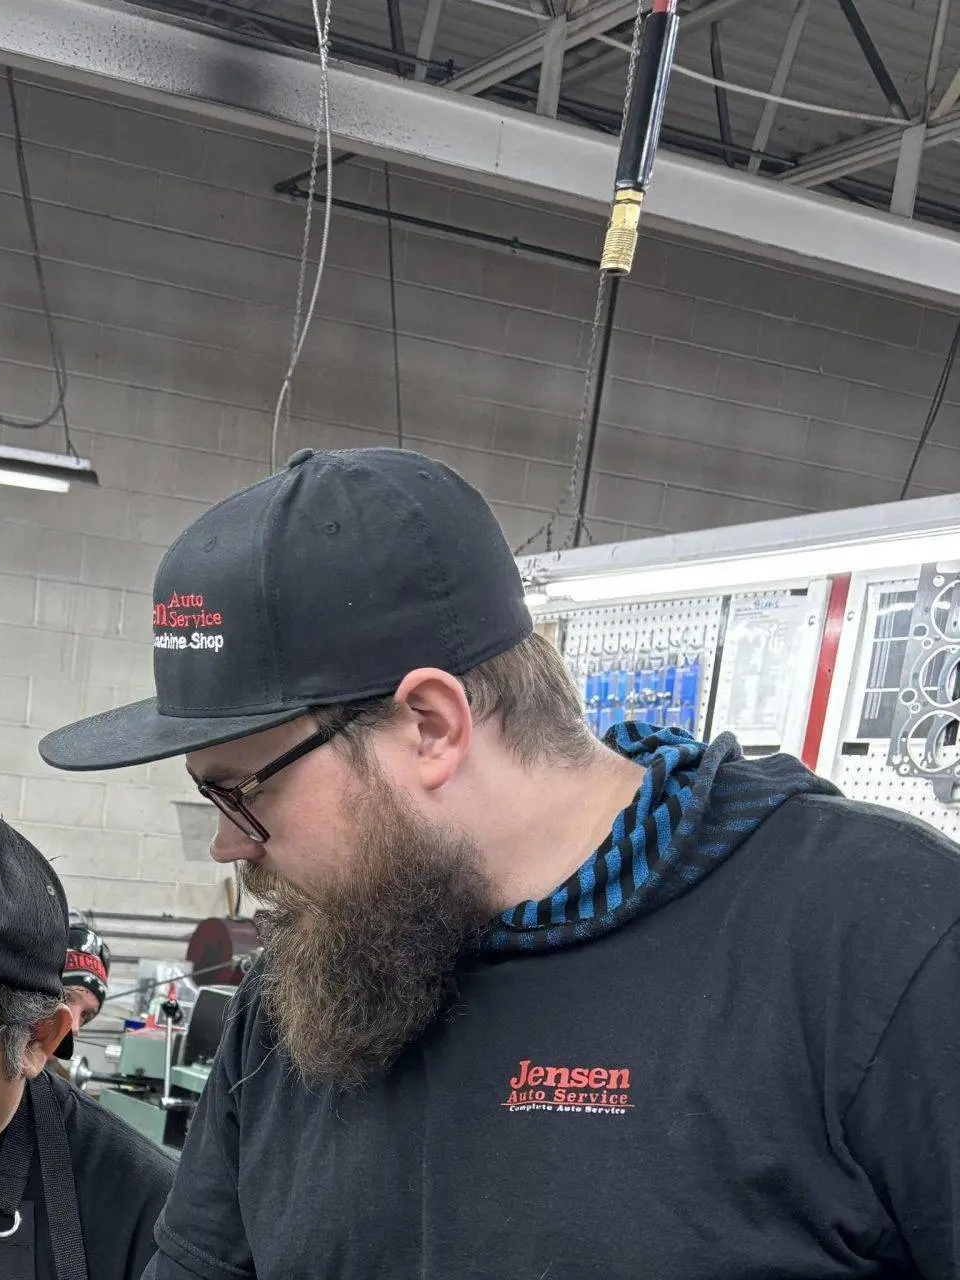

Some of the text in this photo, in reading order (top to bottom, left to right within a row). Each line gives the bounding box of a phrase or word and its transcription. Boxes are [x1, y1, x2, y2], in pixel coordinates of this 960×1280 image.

[168, 590, 203, 608] Auto
[169, 609, 222, 628] Service
[152, 632, 224, 652] achine Shop
[509, 1060, 630, 1089] Jensen
[506, 1089, 628, 1104] Auto Service
[509, 1104, 626, 1115] Complete Auto Service
